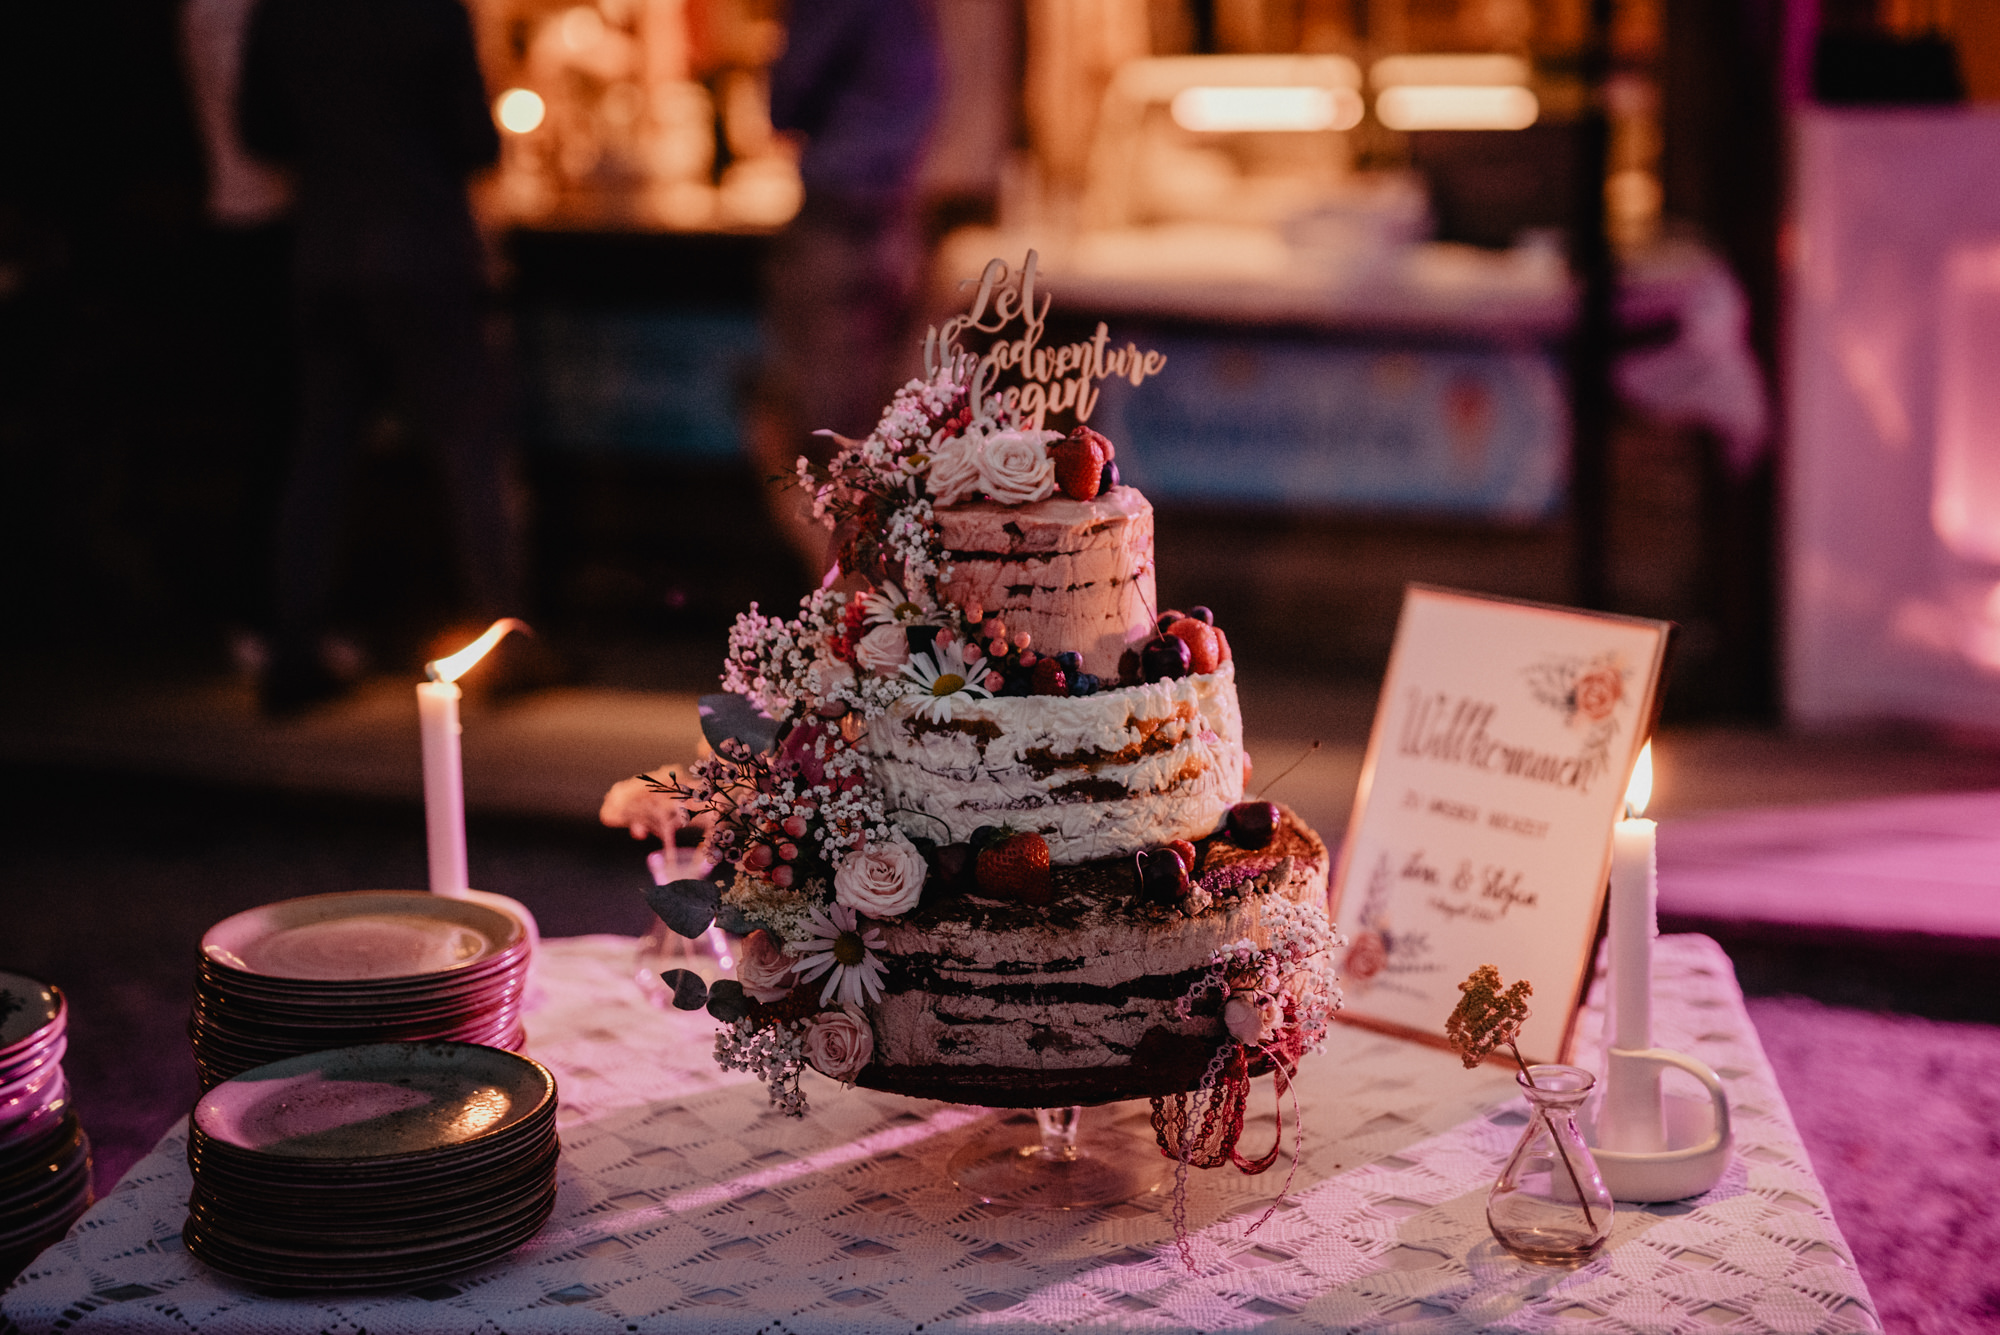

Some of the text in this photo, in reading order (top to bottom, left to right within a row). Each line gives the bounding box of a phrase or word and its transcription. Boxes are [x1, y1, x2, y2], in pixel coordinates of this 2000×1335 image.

[959, 248, 1051, 333] Let
[987, 321, 1167, 386] adventure
[970, 356, 1100, 433] begin
